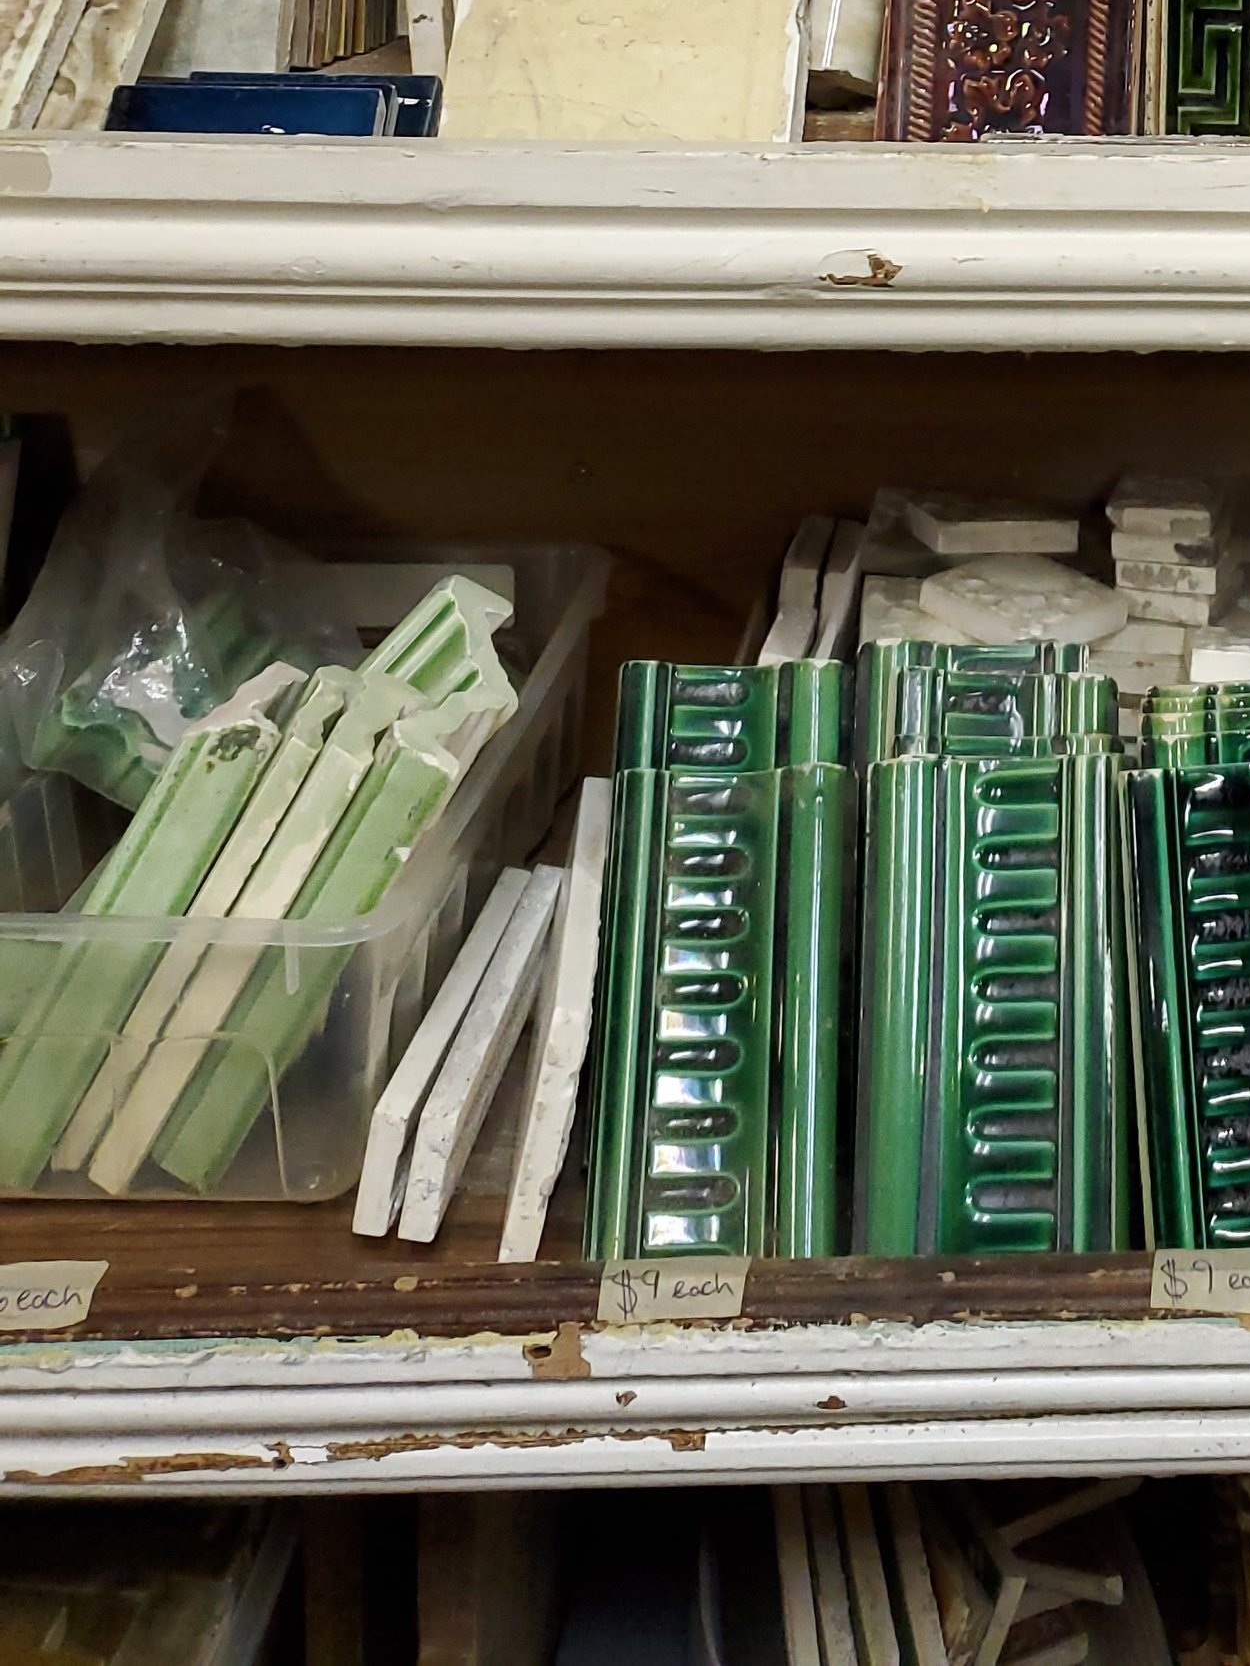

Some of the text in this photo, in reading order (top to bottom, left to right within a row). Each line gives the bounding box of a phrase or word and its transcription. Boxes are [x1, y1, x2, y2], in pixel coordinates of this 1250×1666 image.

[16, 1285, 83, 1311] each
[610, 1269, 734, 1320] $9 each
[1161, 1259, 1213, 1307] $9
